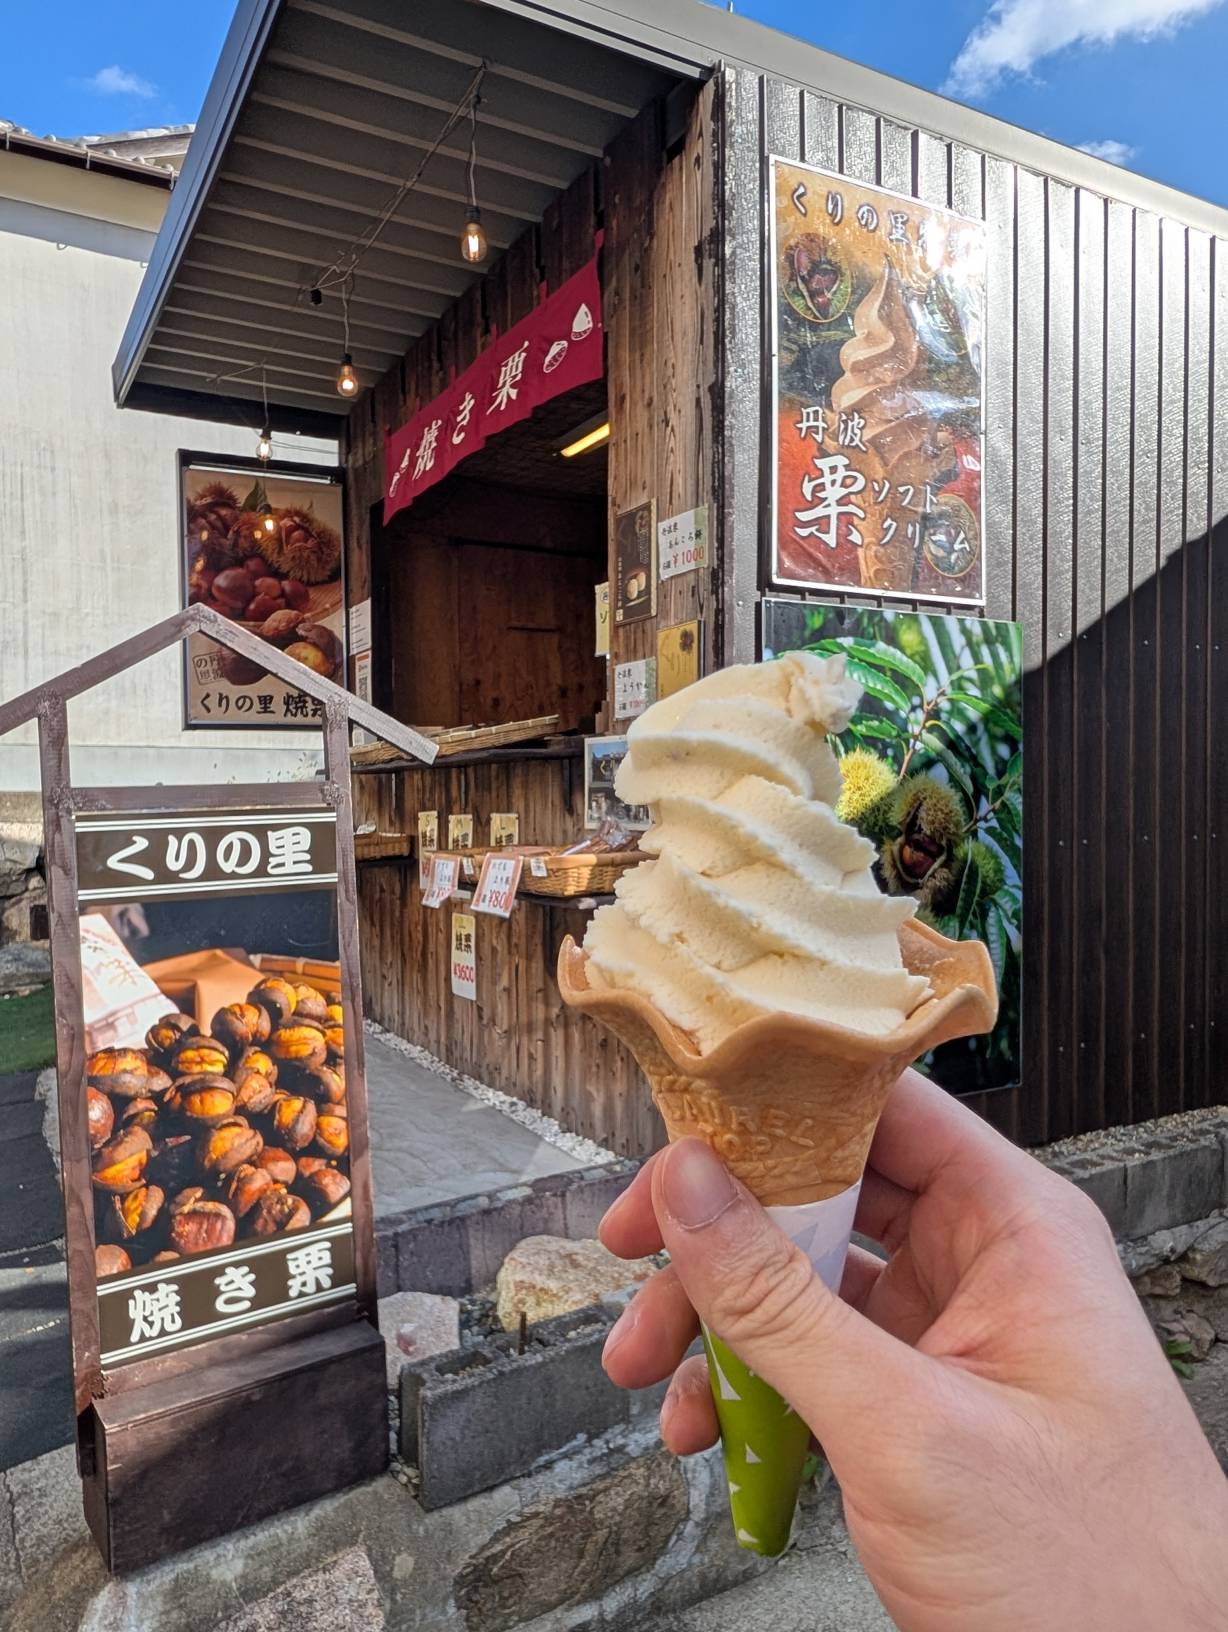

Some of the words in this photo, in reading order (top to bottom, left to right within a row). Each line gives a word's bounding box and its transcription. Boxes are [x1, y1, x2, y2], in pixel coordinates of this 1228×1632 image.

[792, 182, 909, 246] くりの里
[412, 340, 529, 480] 焼き栗
[795, 406, 868, 453] 丹波
[794, 455, 866, 549] 栗
[872, 479, 938, 513] ソフト
[672, 545, 705, 569] ¥1000
[880, 517, 971, 552] クリーム
[200, 691, 276, 714] くりの里
[106, 826, 313, 881] くりの里
[128, 1240, 334, 1343] 焼き栗
